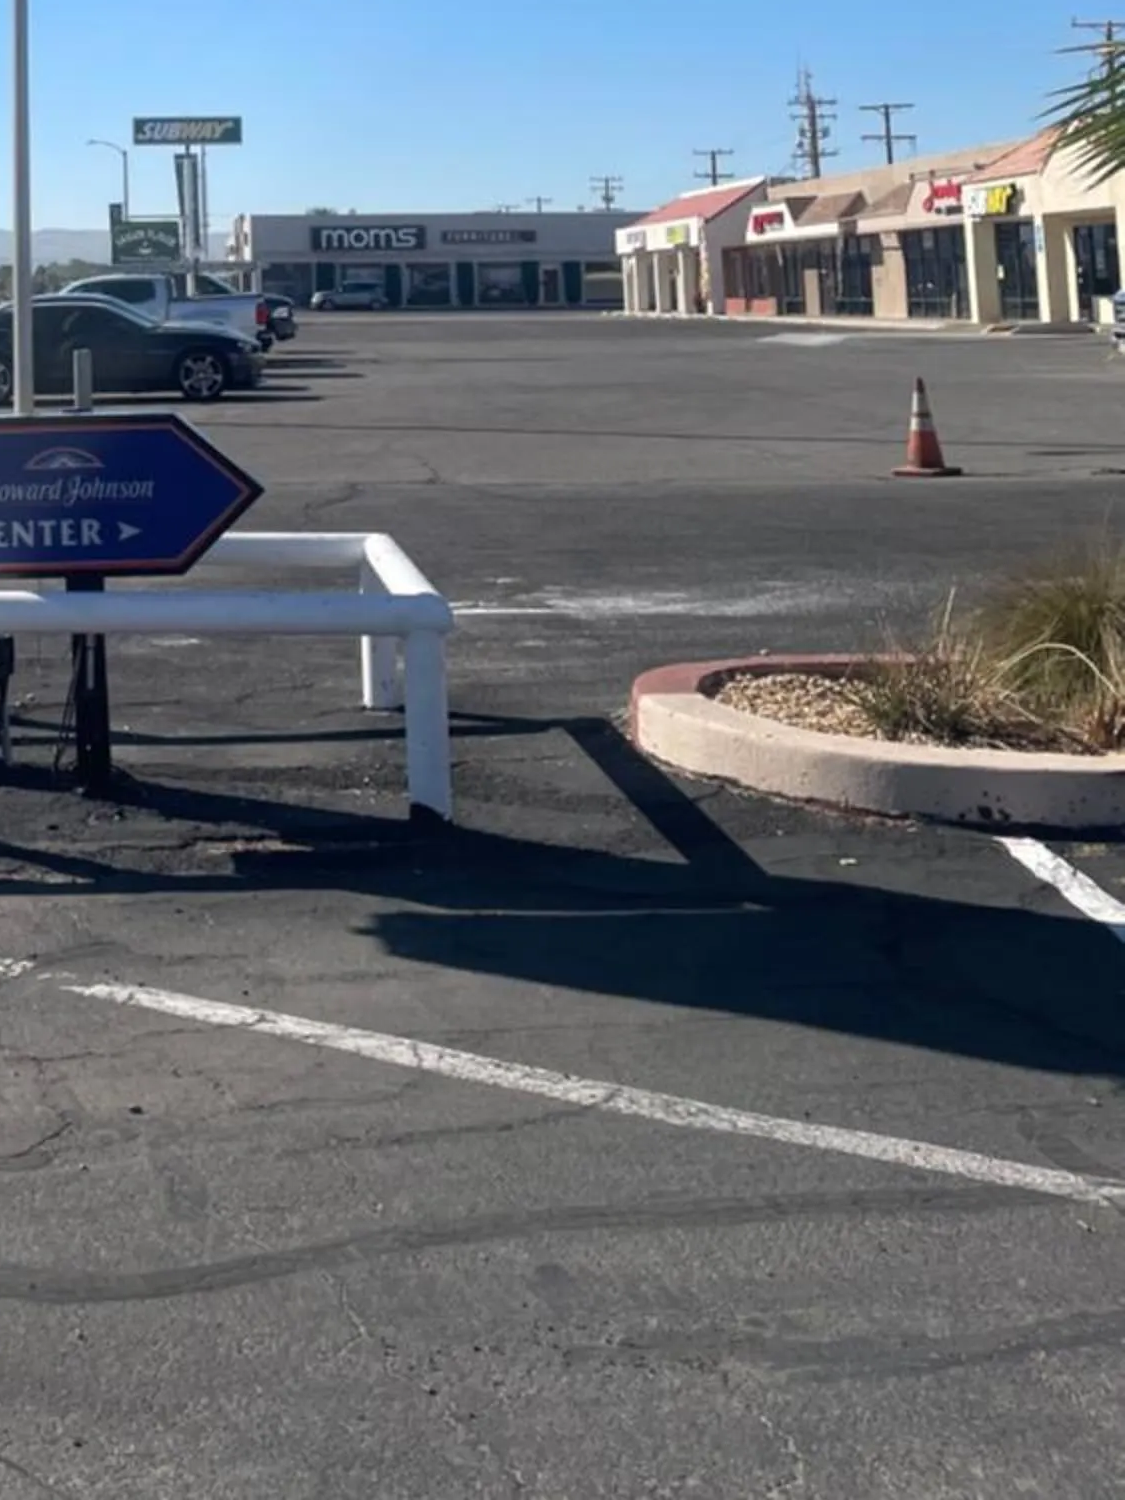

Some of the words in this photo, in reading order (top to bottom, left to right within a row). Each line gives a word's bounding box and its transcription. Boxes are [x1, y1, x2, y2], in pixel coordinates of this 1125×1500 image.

[137, 120, 234, 141] SUBWAY
[320, 227, 418, 250] moms
[62, 474, 155, 508] Johnson
